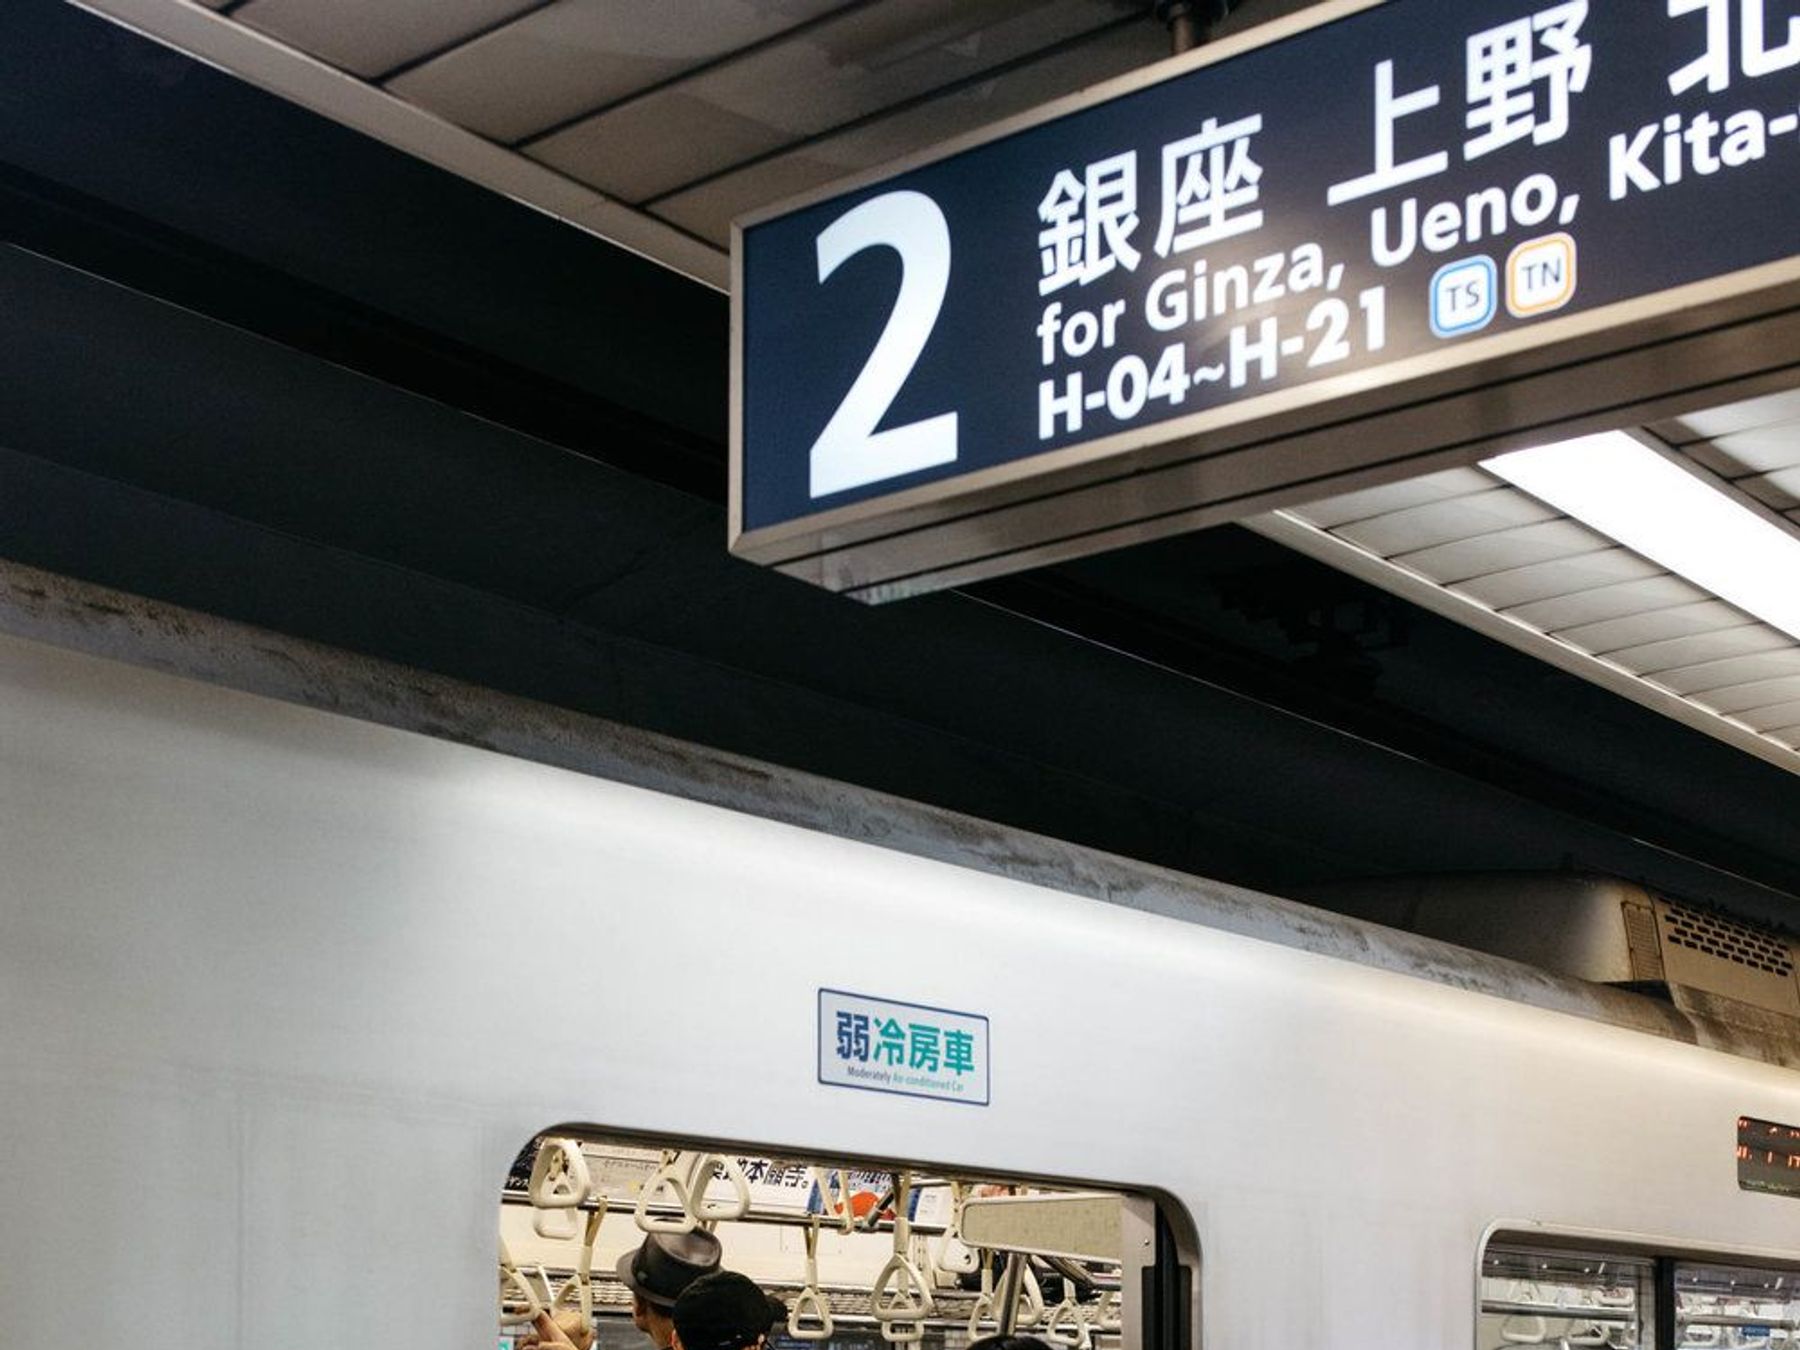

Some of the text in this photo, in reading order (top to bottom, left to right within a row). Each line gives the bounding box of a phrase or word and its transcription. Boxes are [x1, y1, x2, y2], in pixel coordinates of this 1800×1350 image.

[1036, 108, 1800, 366] for Ginza, Ueno, Kita-
[1037, 0, 1800, 297] 銀座 上野 北
[809, 189, 958, 499] 2
[1445, 278, 1481, 314] TS
[1520, 255, 1562, 292] TN
[836, 1010, 975, 1077] 弱冷房車
